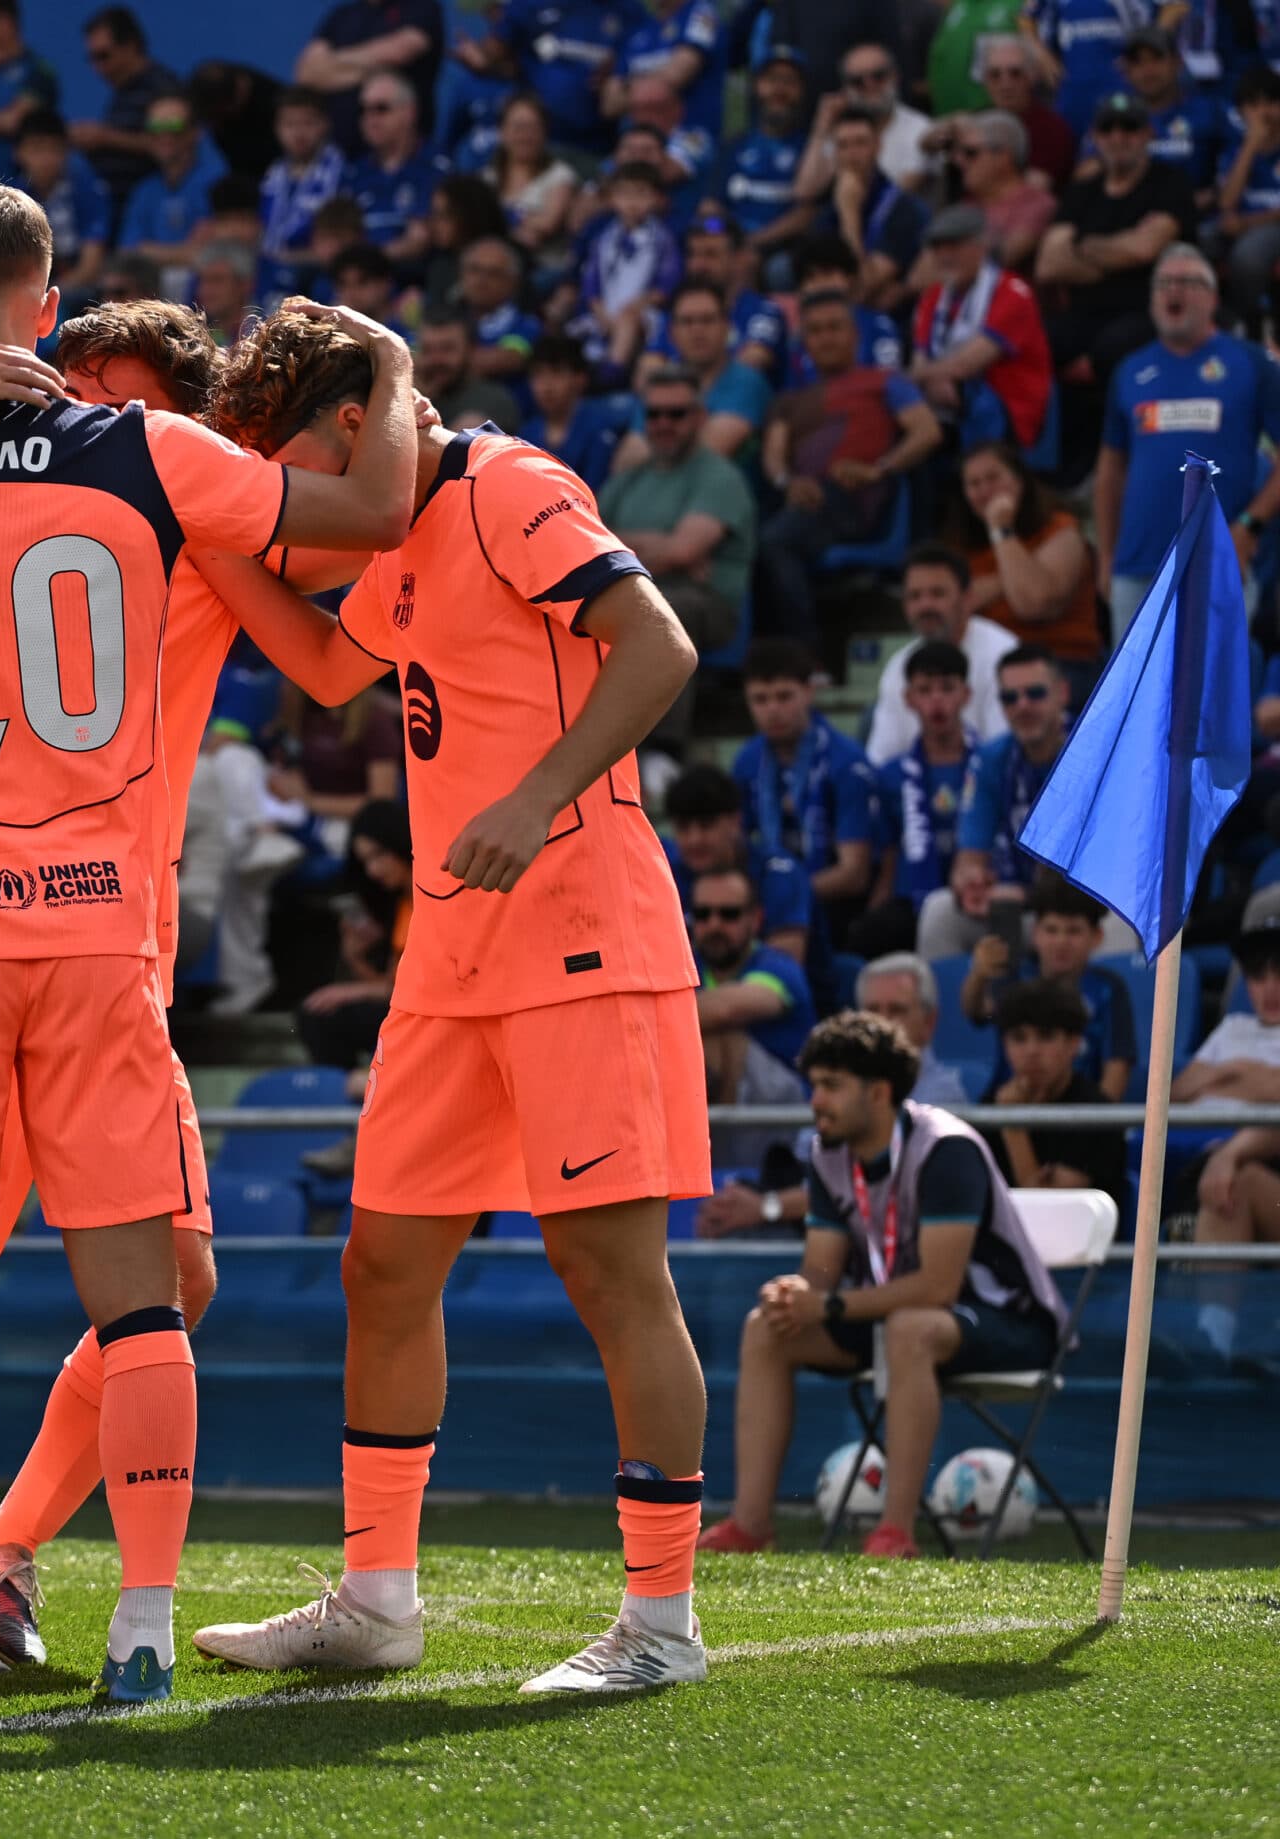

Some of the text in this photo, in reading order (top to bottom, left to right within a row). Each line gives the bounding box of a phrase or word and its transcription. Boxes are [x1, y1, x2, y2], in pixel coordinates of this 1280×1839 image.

[38, 861, 119, 882] UNHCR
[43, 878, 122, 901] ACNUR
[45, 901, 60, 909] The
[72, 897, 100, 905] Refugee
[100, 896, 123, 904] Agency
[126, 1467, 189, 1485] BARÇA
